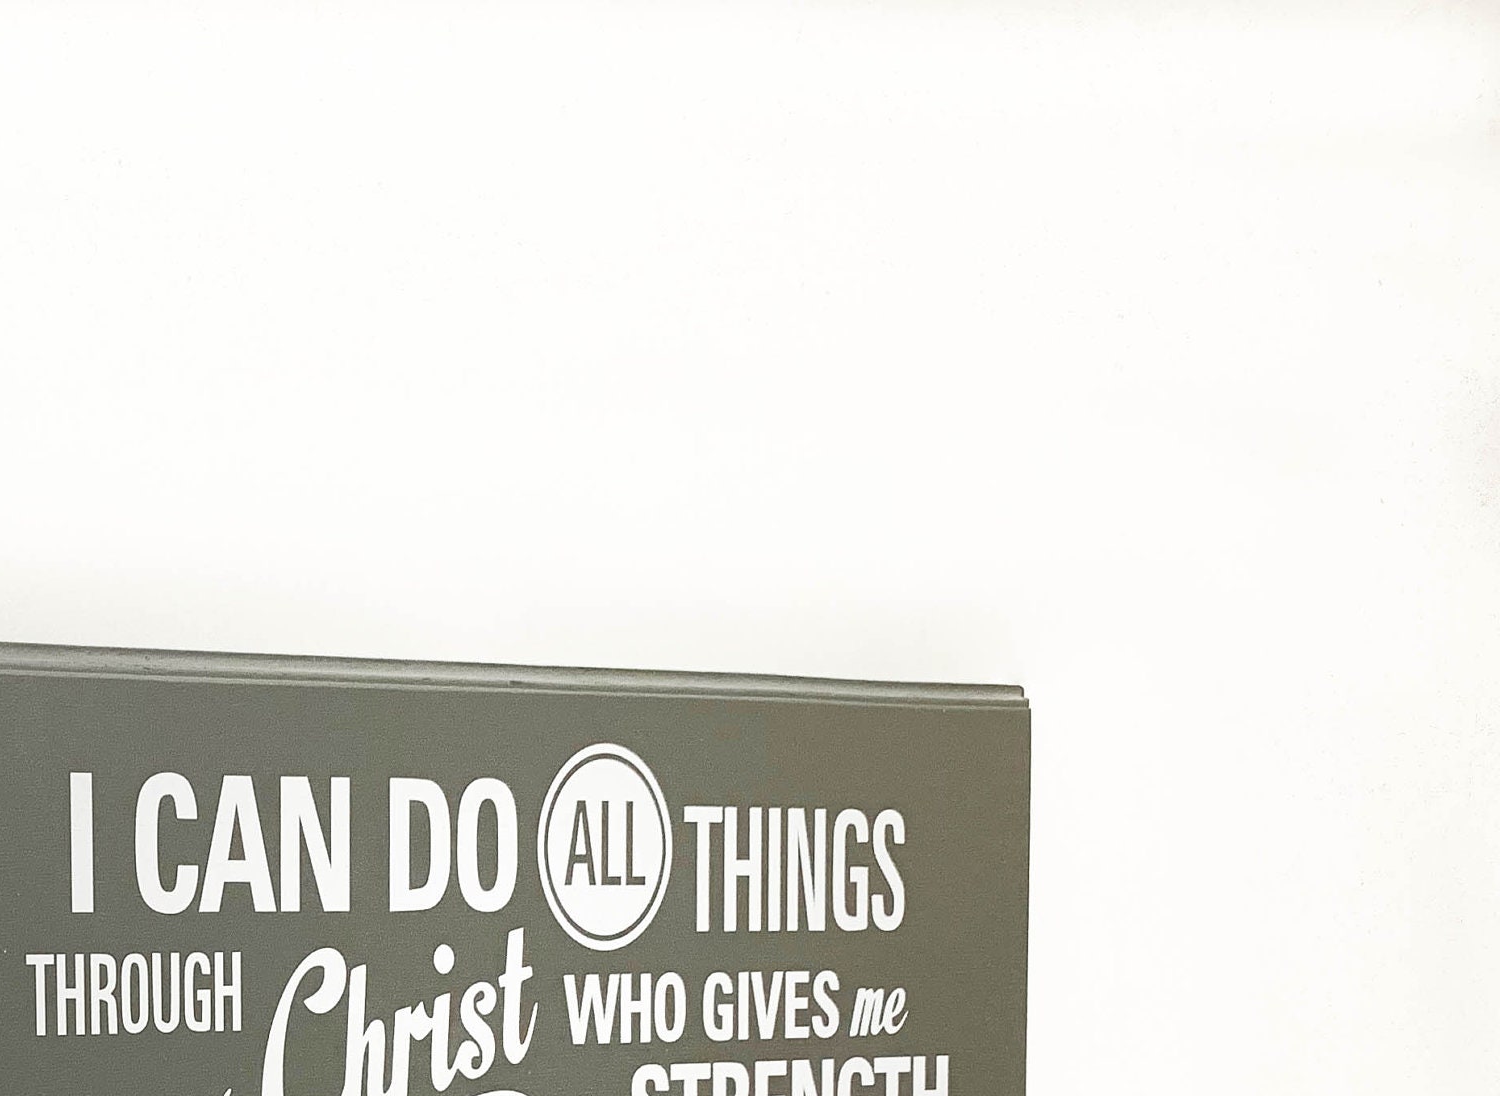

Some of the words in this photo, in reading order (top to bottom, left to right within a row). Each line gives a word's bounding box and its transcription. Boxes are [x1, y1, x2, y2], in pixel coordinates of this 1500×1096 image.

[68, 770, 94, 915] I
[132, 773, 351, 915] CAN
[389, 776, 519, 916] DO
[563, 798, 647, 888] ALL
[683, 805, 906, 934] THINGS
[25, 950, 243, 1037] THROUGH
[563, 974, 682, 1045] WHO
[702, 970, 840, 1043] GIVES
[848, 981, 908, 1040] me
